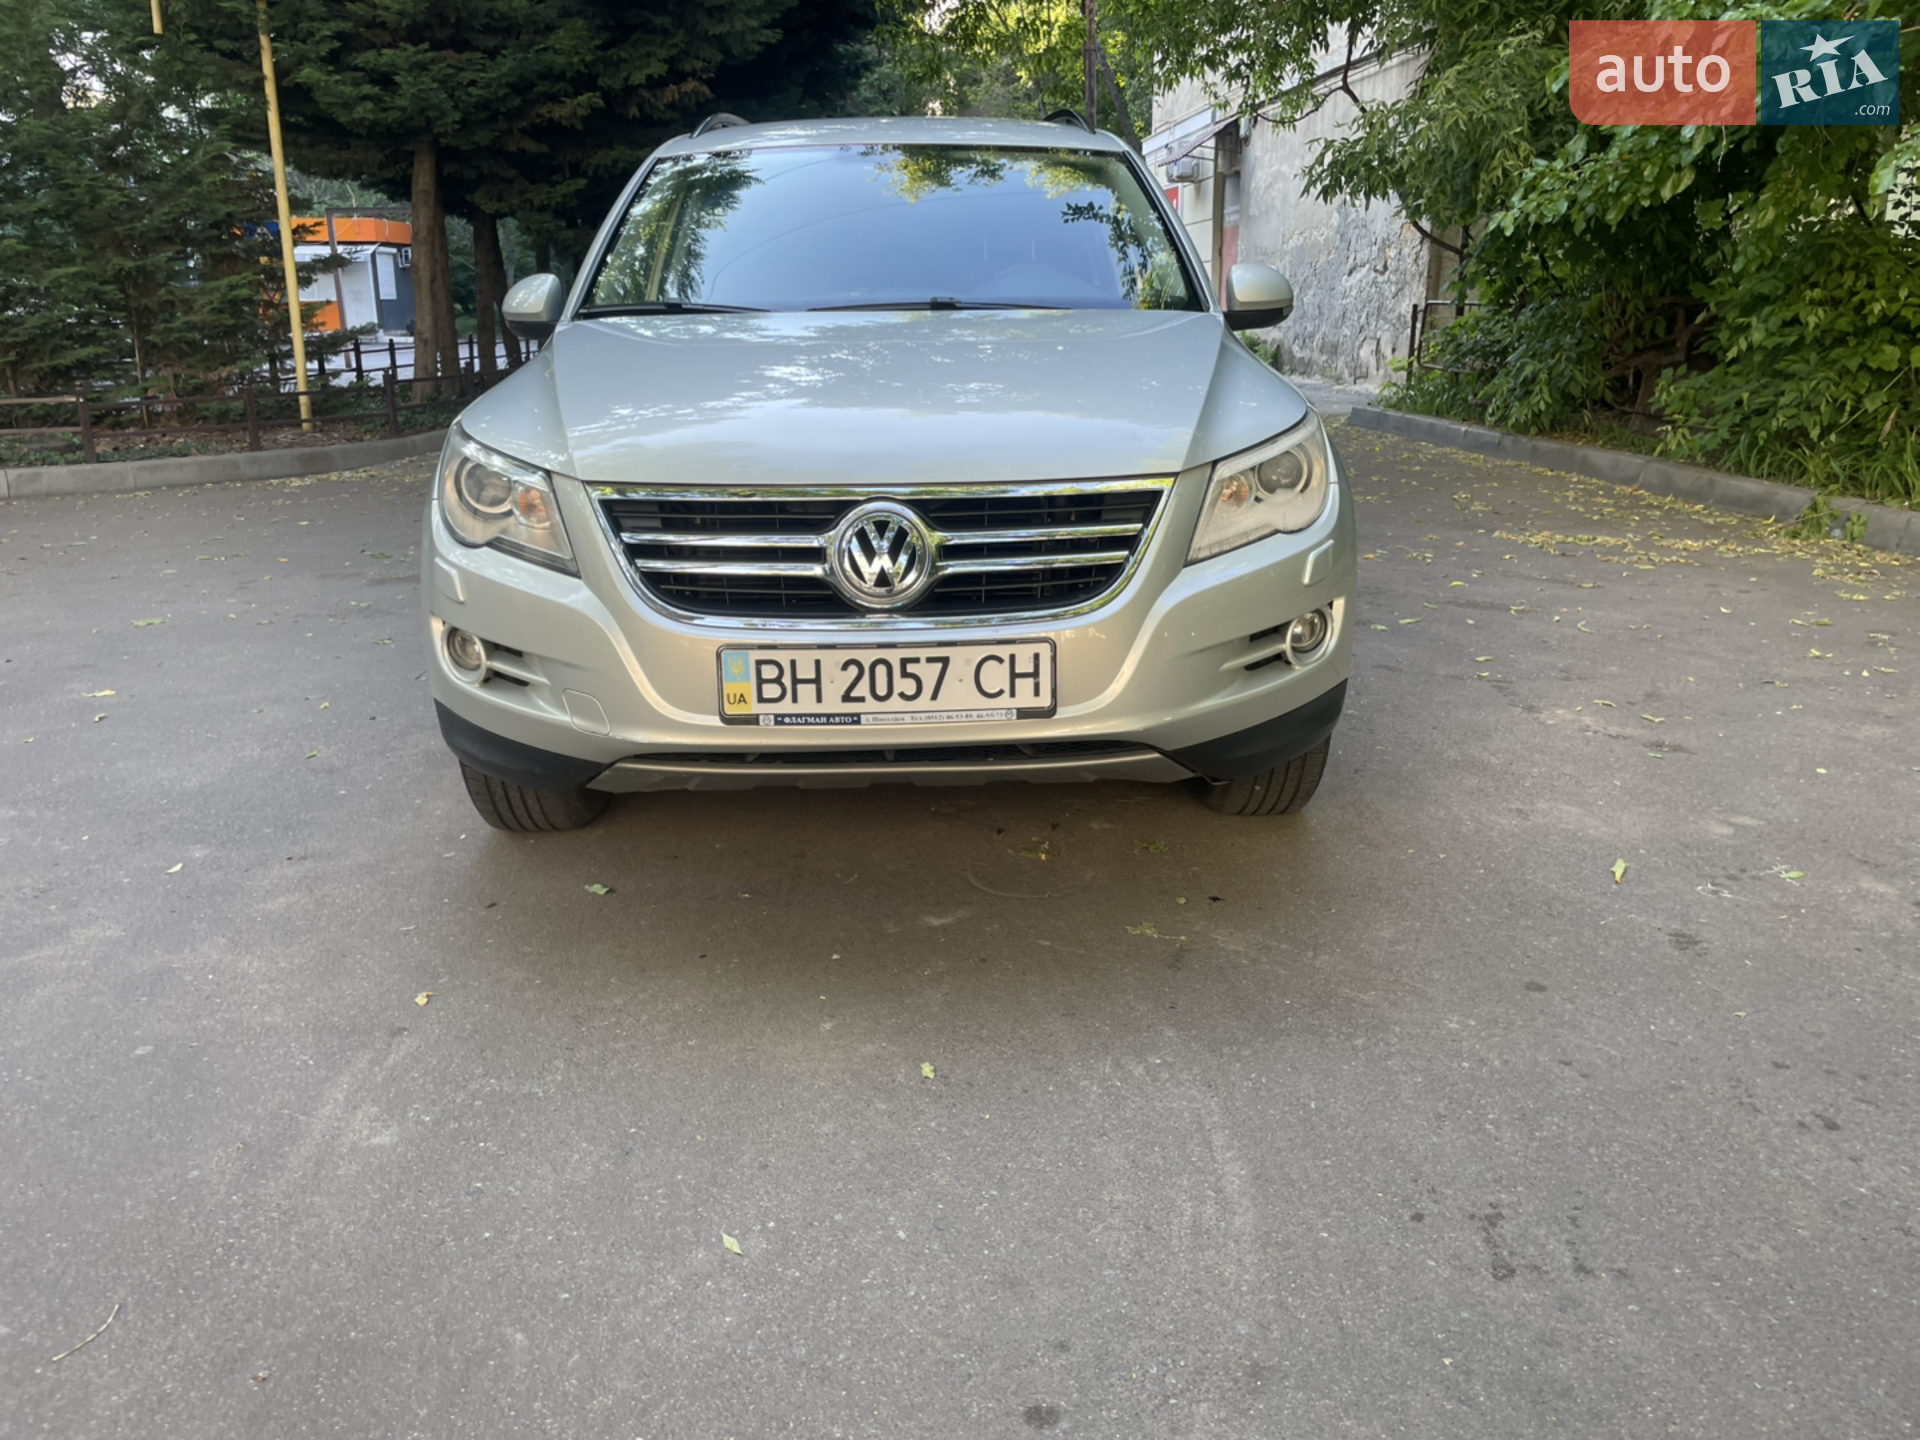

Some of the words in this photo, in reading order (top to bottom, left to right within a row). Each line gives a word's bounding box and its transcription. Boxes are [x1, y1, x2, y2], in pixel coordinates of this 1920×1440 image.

[755, 658, 823, 704] BH
[840, 655, 950, 703] 2057
[974, 652, 1040, 699] CH
[726, 693, 748, 705] UA
